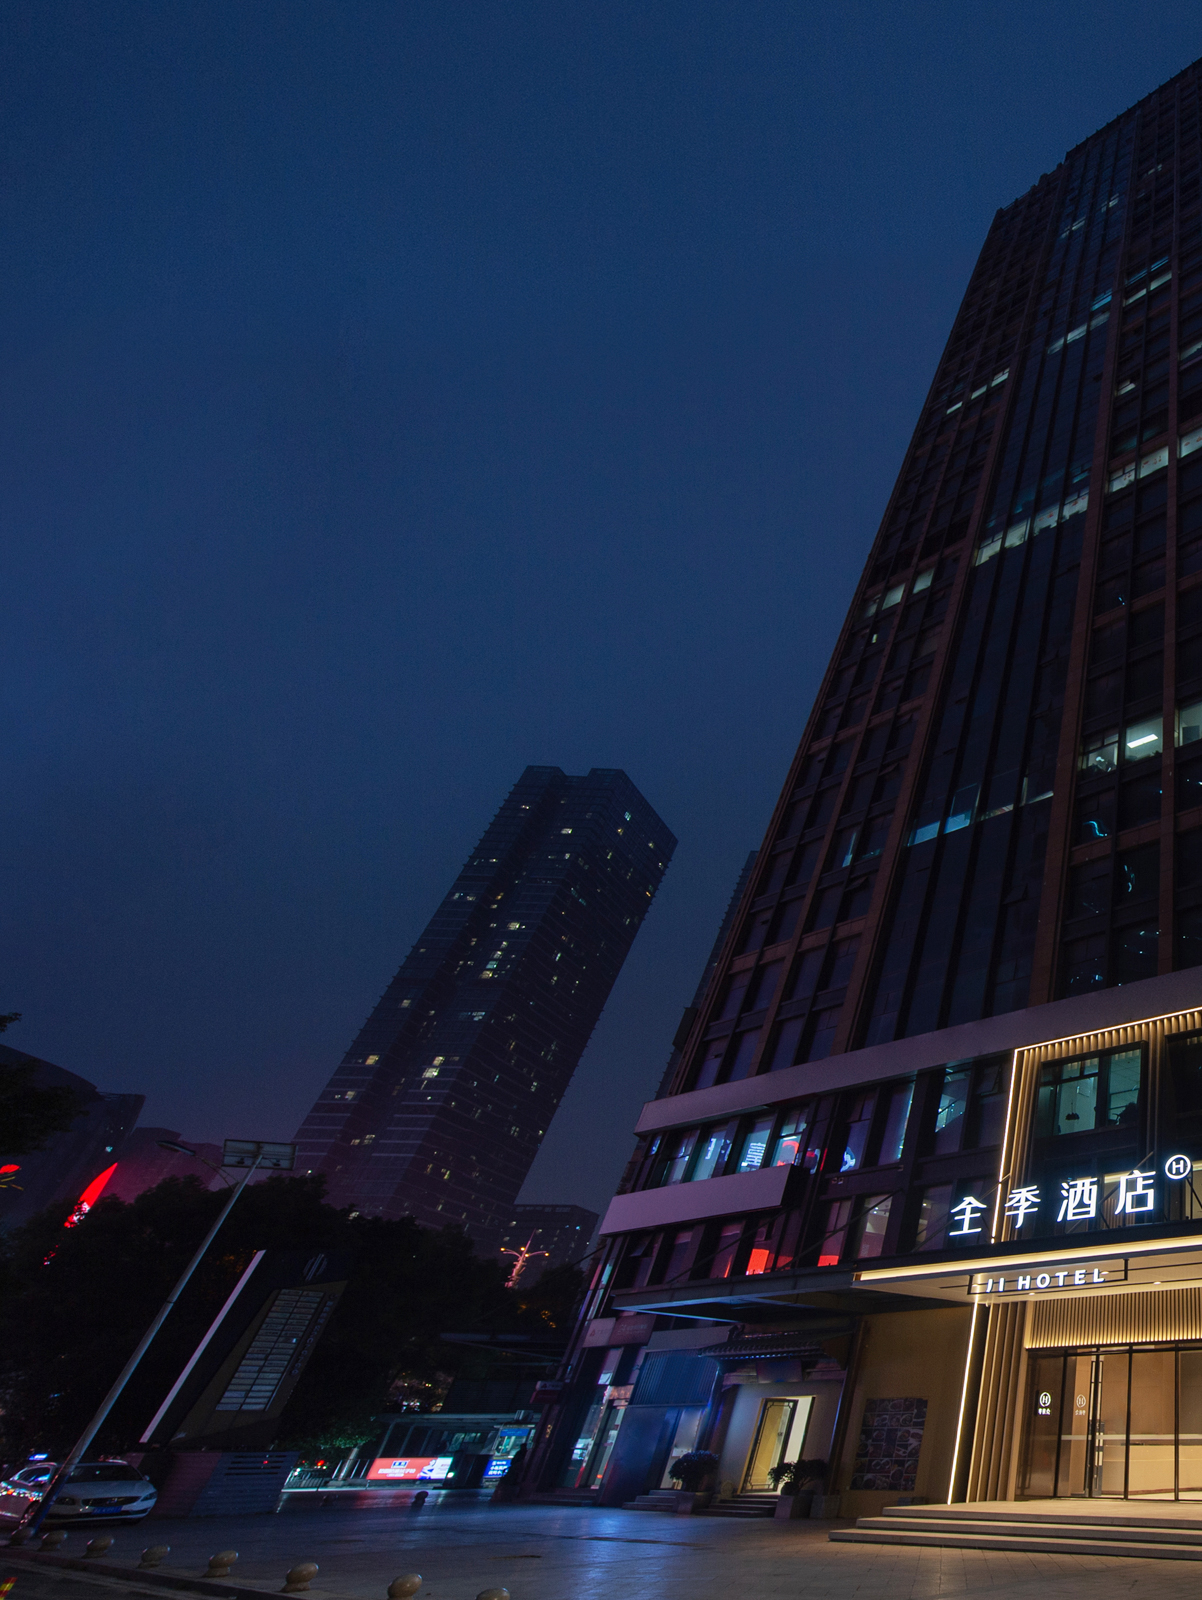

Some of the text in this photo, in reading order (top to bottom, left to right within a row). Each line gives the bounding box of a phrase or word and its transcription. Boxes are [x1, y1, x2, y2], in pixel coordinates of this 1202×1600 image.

[949, 1170, 1156, 1236] 全季酒店
[986, 1268, 1105, 1293] JI HOTEL
